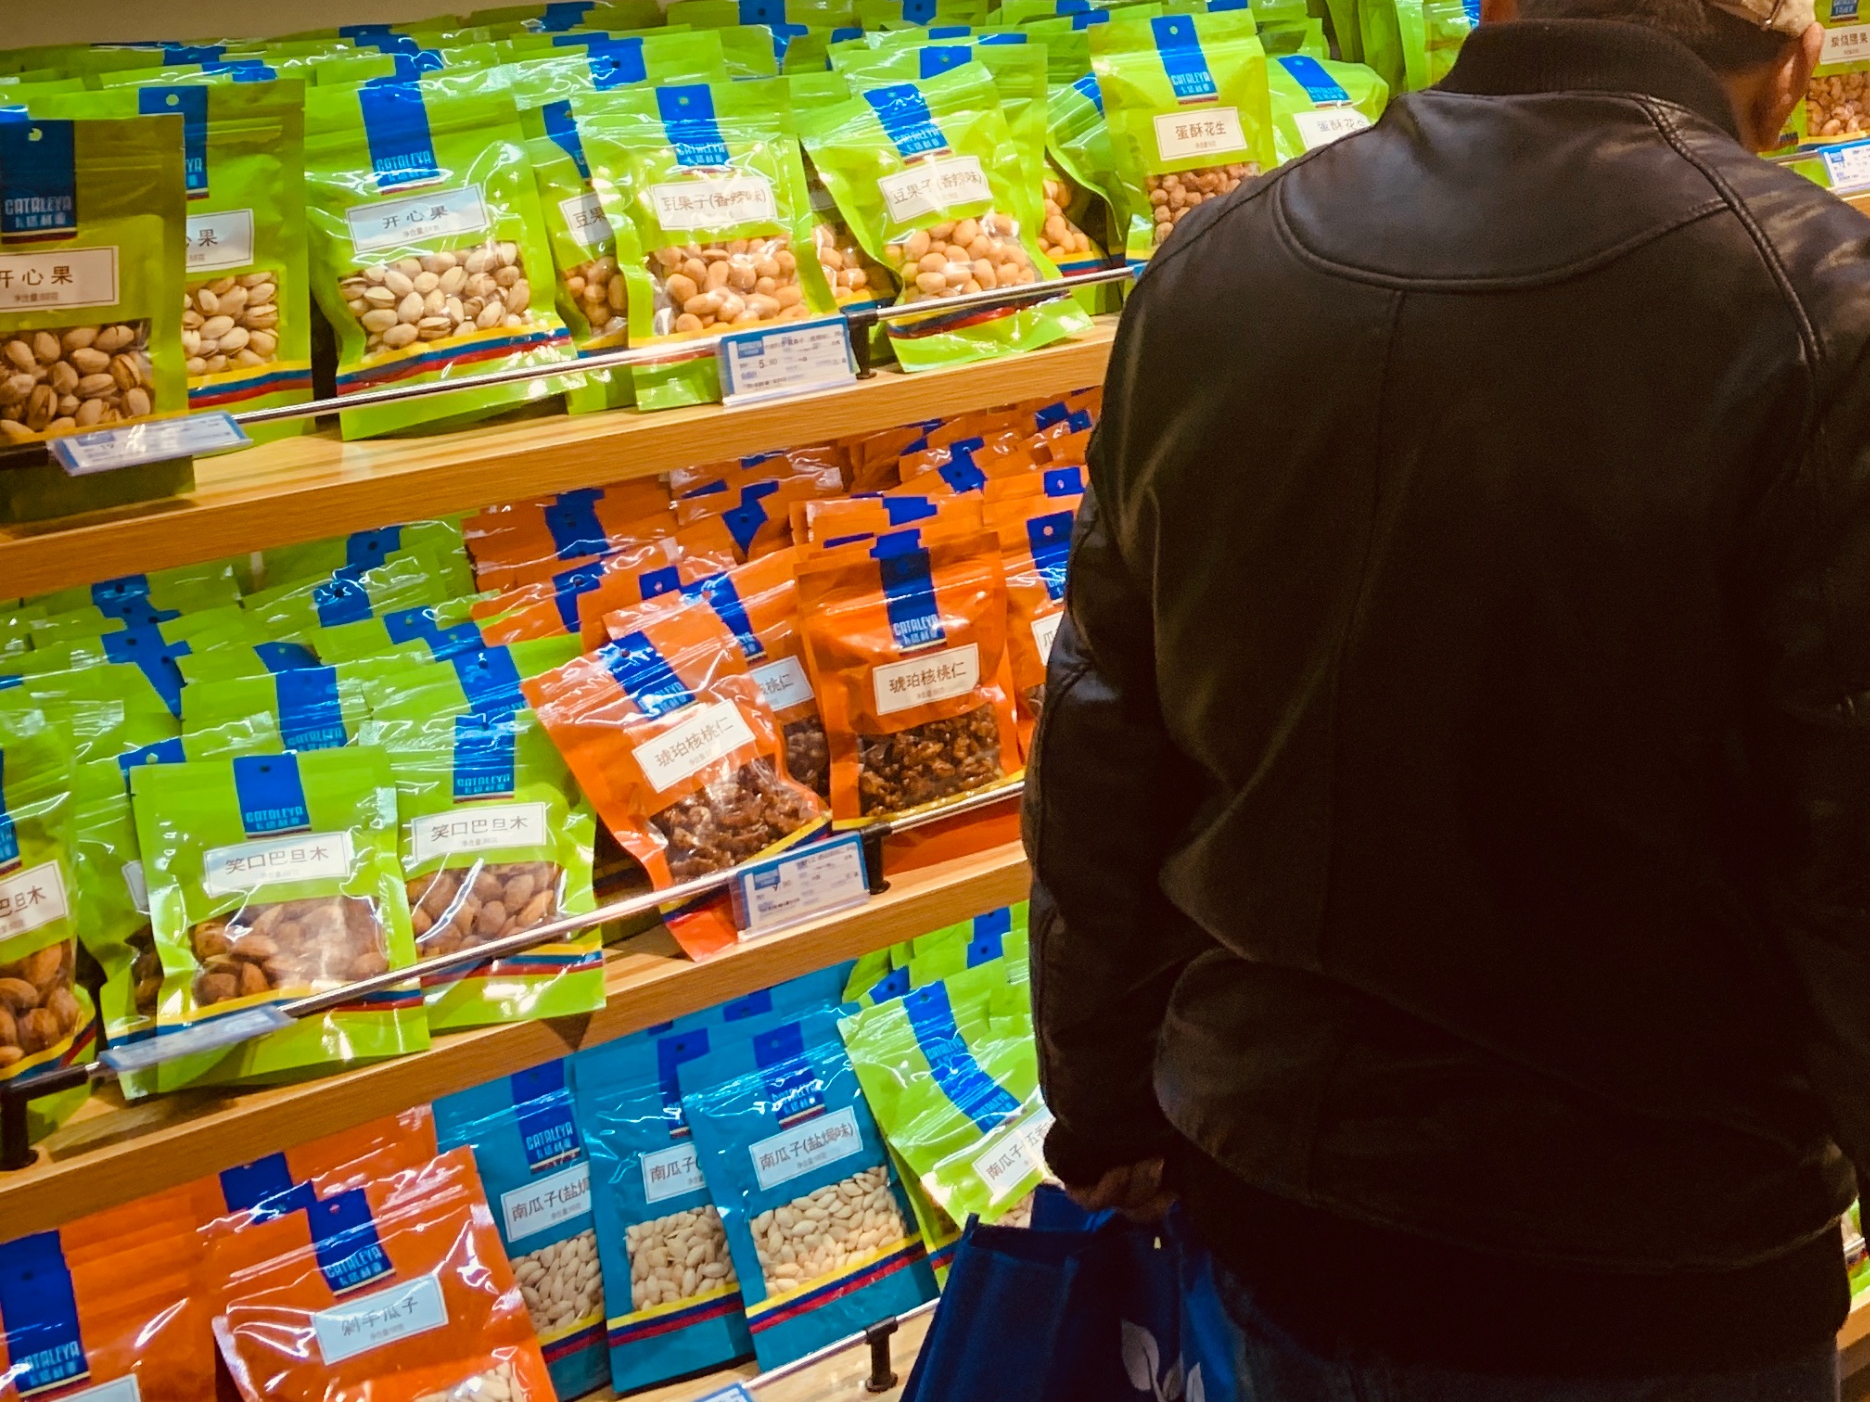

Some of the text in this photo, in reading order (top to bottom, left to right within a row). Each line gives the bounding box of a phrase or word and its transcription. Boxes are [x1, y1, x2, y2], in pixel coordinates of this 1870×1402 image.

[1171, 70, 1210, 87] CATALEYA
[1174, 120, 1227, 141] 蛋酥花生
[375, 150, 433, 172] CATALEYA
[892, 170, 982, 206] 豆果子(香辣味)
[4, 197, 73, 215] CATALEYA
[382, 204, 449, 229] 开心果
[0, 265, 74, 288] 开心果
[892, 614, 940, 638] CATALEYA
[888, 661, 968, 695] 琥珀核桃仁
[653, 715, 735, 768] 琥珀核桃仁
[456, 773, 511, 788] CATALEYA
[245, 805, 304, 824] CATALEYA
[430, 815, 529, 842] 笑口巴旦木
[224, 846, 330, 875] 笑口巴旦木
[525, 1120, 574, 1151] CATALEYA
[758, 1121, 855, 1173] 南瓜子(盐焗味)
[326, 1246, 383, 1278] CATALEYA
